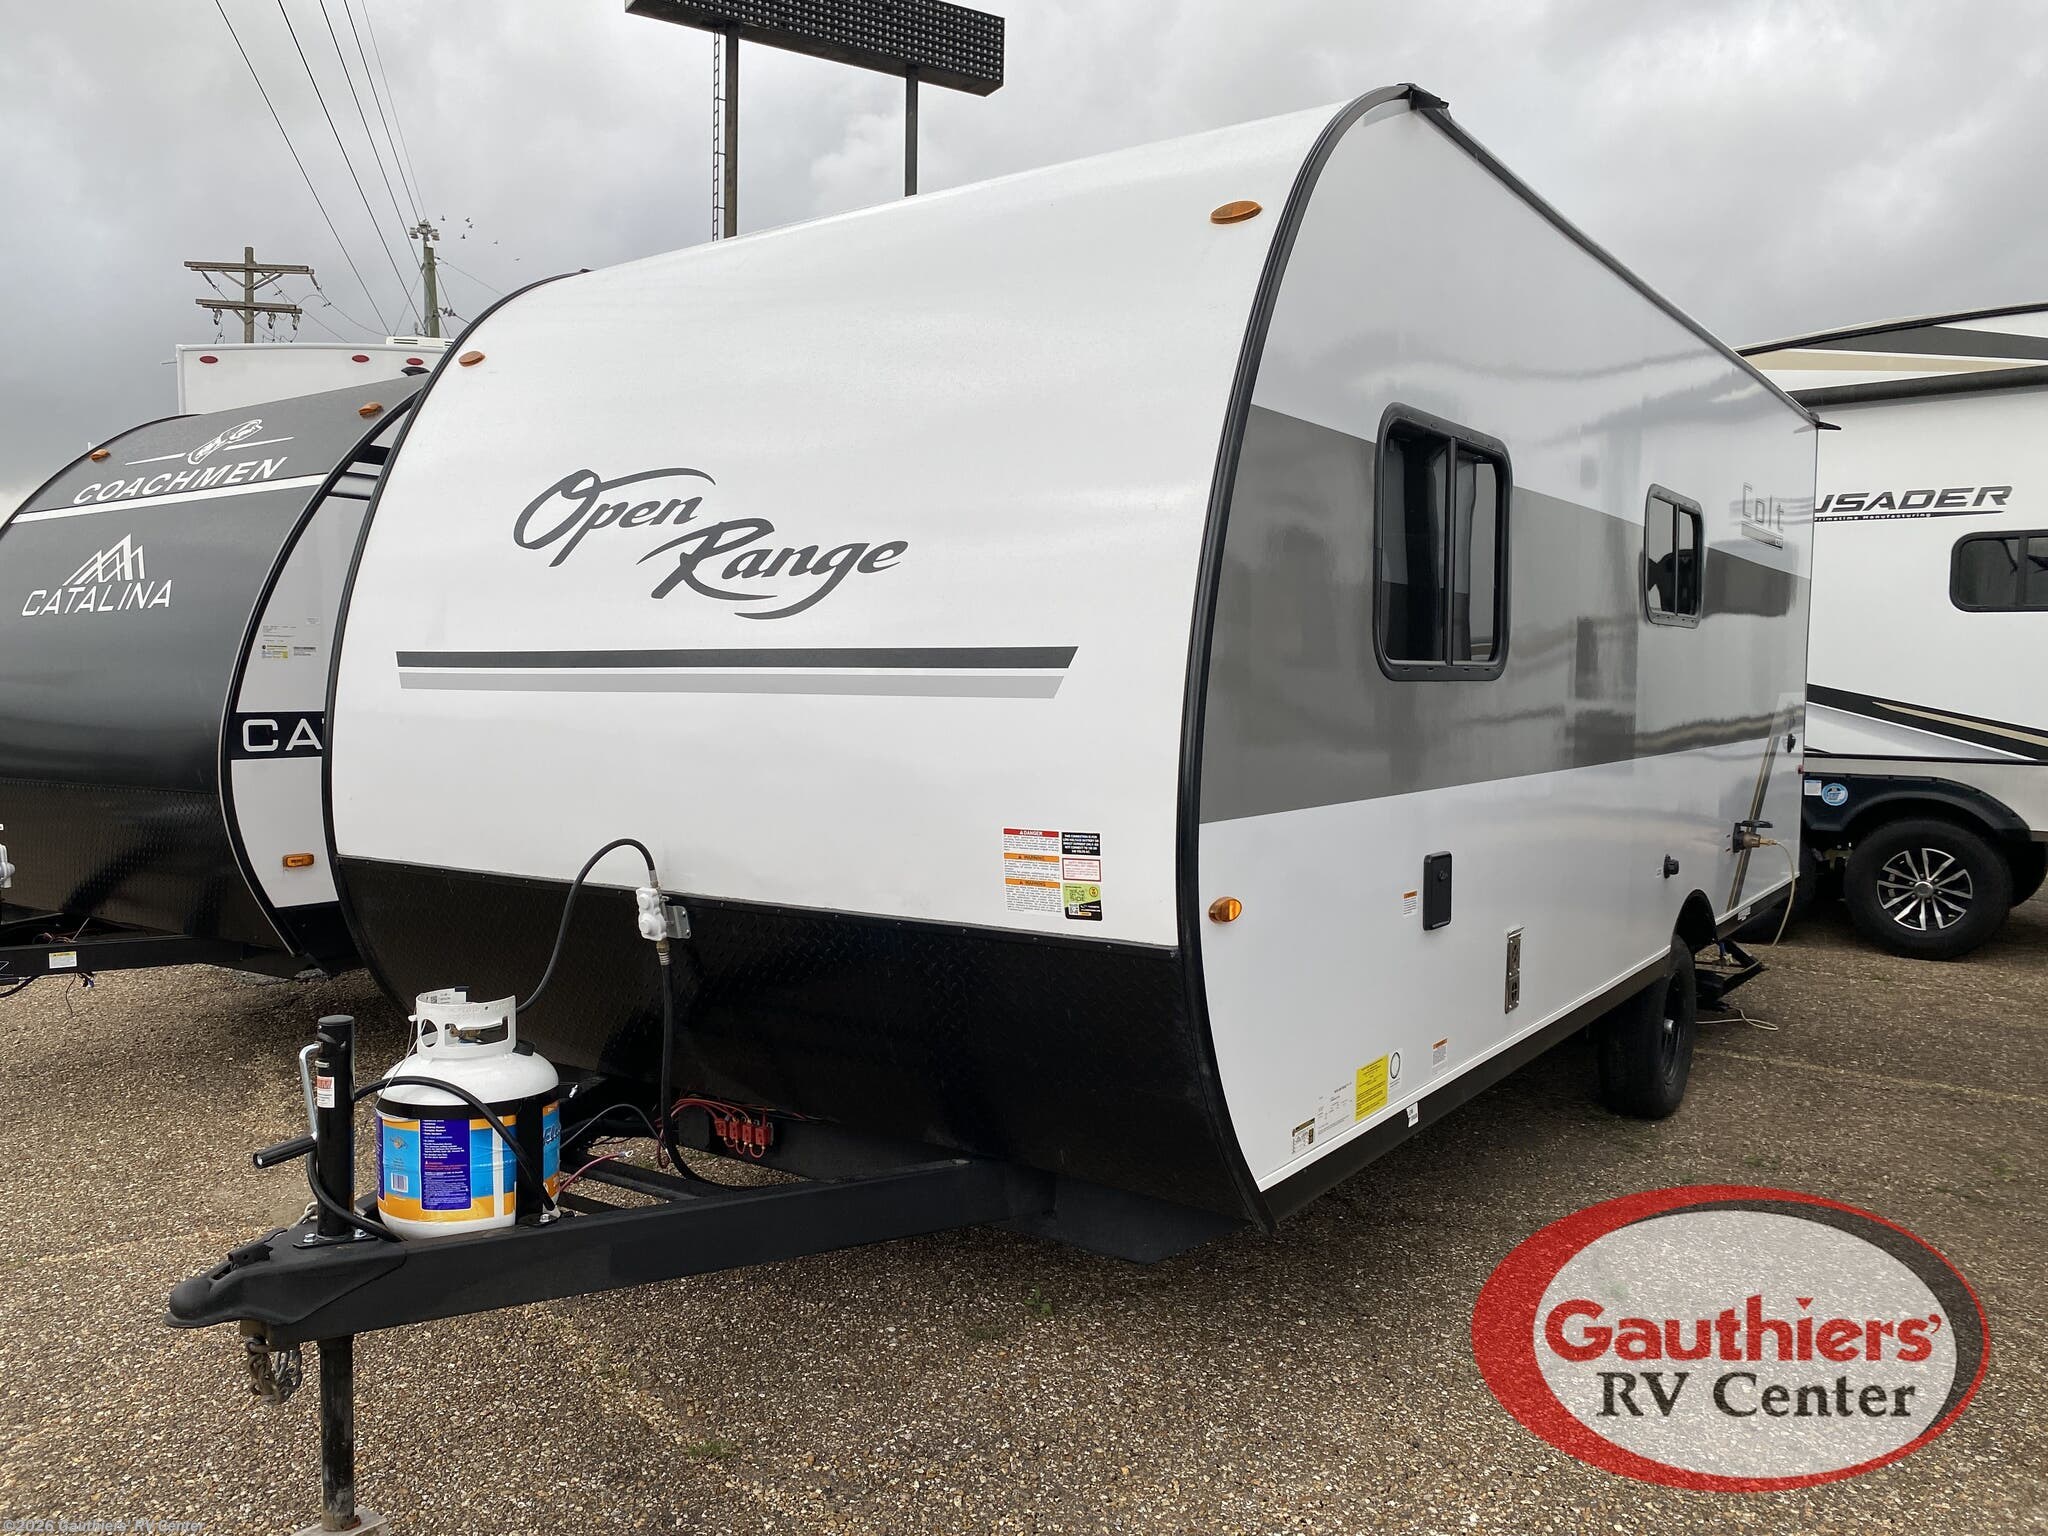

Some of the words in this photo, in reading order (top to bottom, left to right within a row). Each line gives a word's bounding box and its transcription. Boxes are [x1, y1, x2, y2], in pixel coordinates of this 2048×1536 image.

[73, 456, 288, 505] COACHMEN
[1742, 482, 1785, 532] Colt
[513, 467, 717, 568] Open
[636, 517, 909, 621] Range
[21, 579, 173, 617] CATALINA
[242, 718, 324, 752] CA
